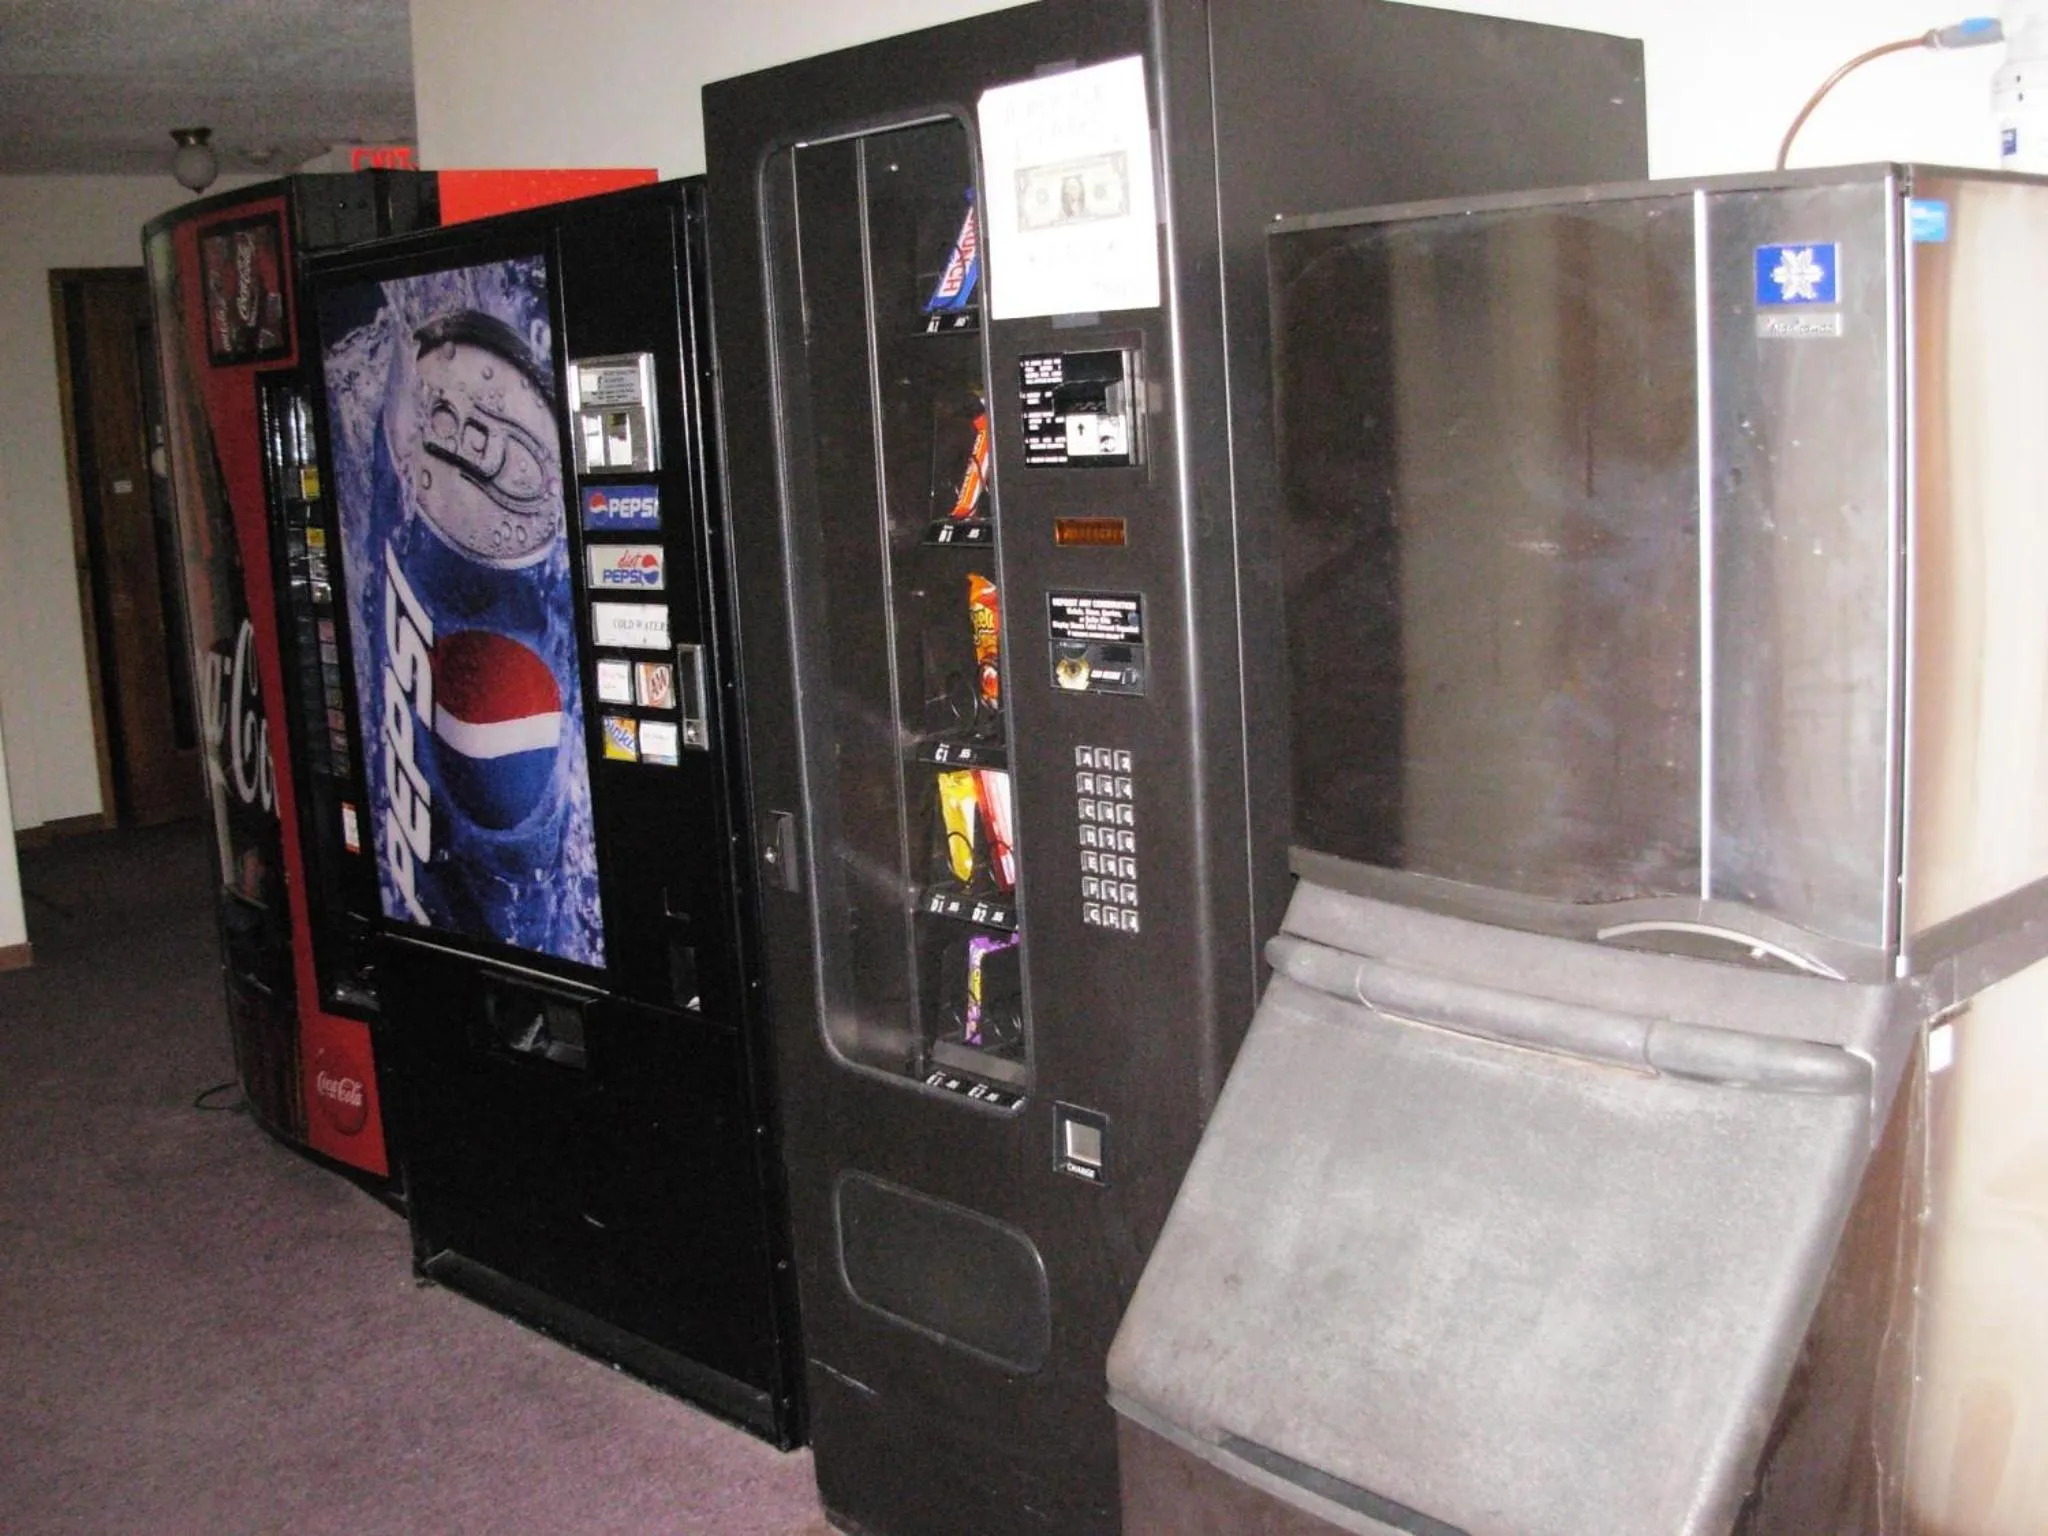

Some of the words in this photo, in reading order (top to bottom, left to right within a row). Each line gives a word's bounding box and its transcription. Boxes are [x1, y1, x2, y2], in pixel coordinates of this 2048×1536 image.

[608, 497, 660, 518] PEPSI
[617, 550, 643, 569] diet
[602, 568, 644, 587] PEPSI
[385, 537, 434, 927] PEPSI
